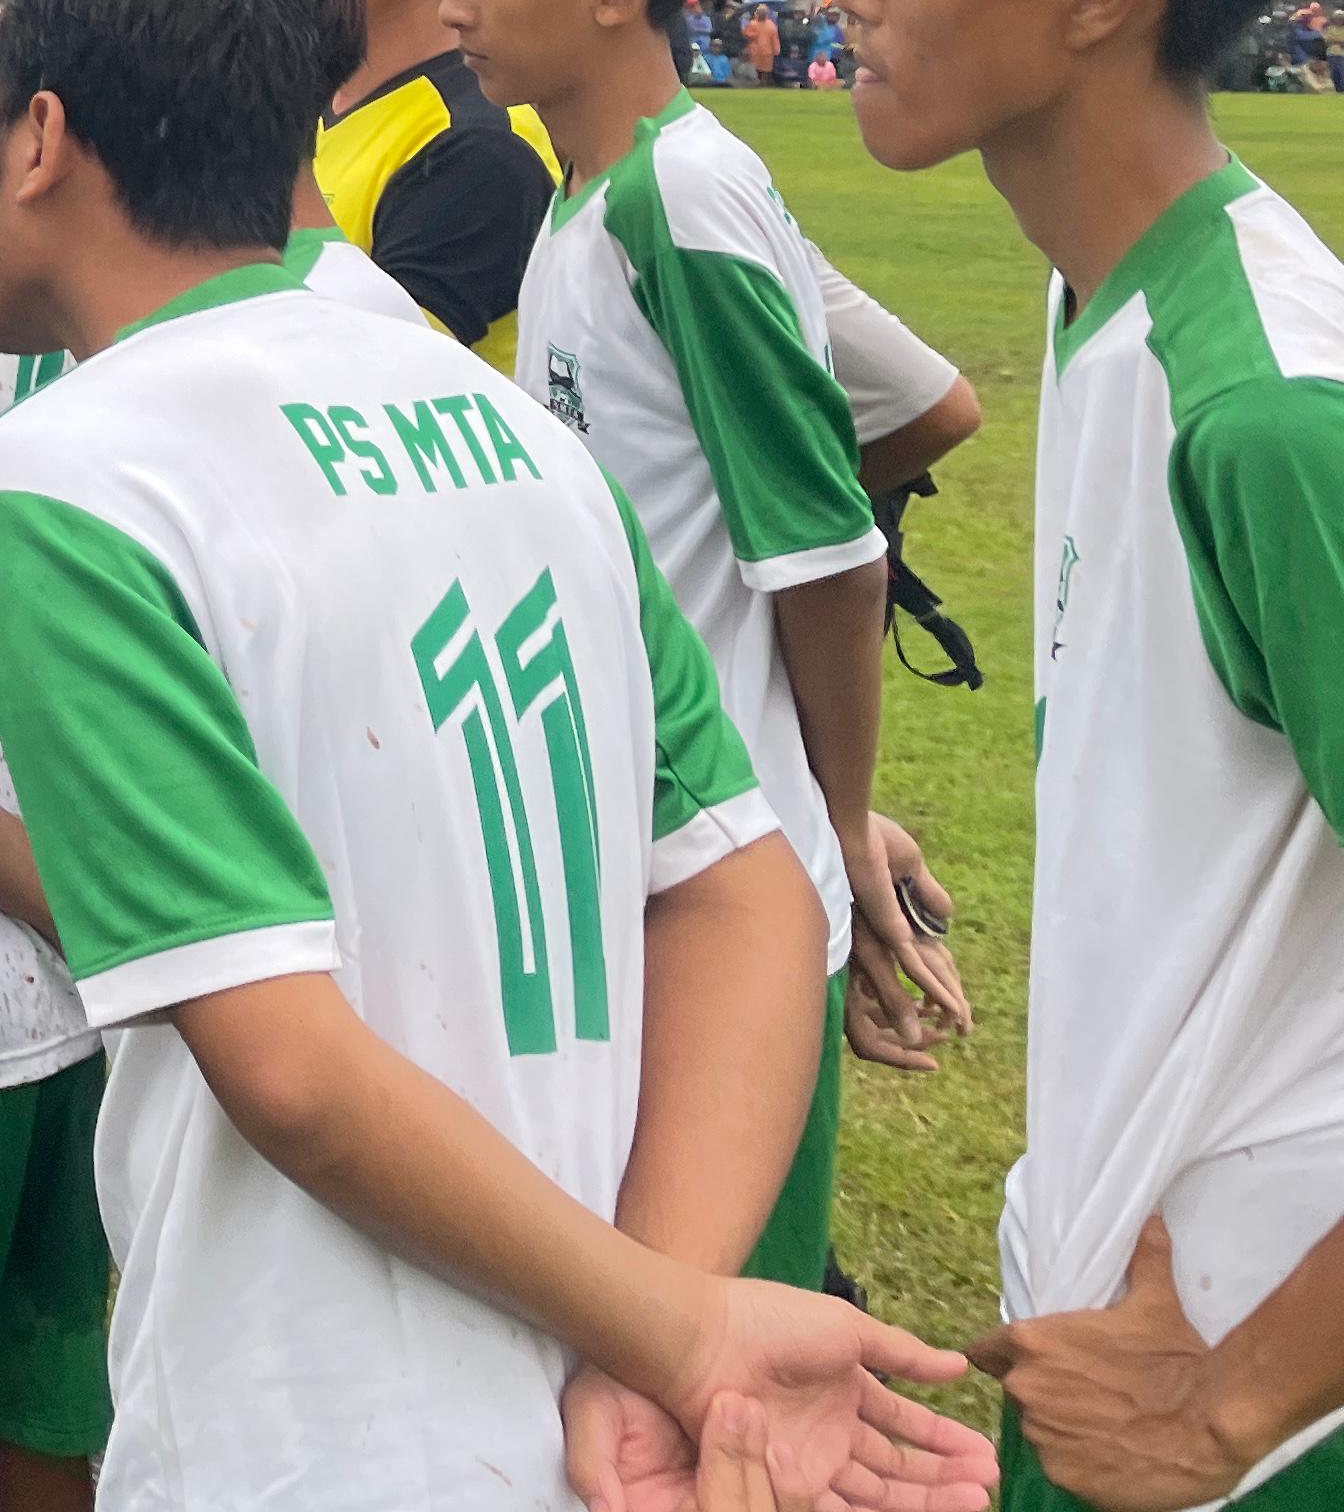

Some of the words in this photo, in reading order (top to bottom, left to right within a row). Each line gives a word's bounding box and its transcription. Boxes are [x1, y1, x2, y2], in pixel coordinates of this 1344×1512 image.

[278, 403, 399, 496] PS
[381, 392, 543, 494] MTA
[410, 564, 612, 1057] 11
